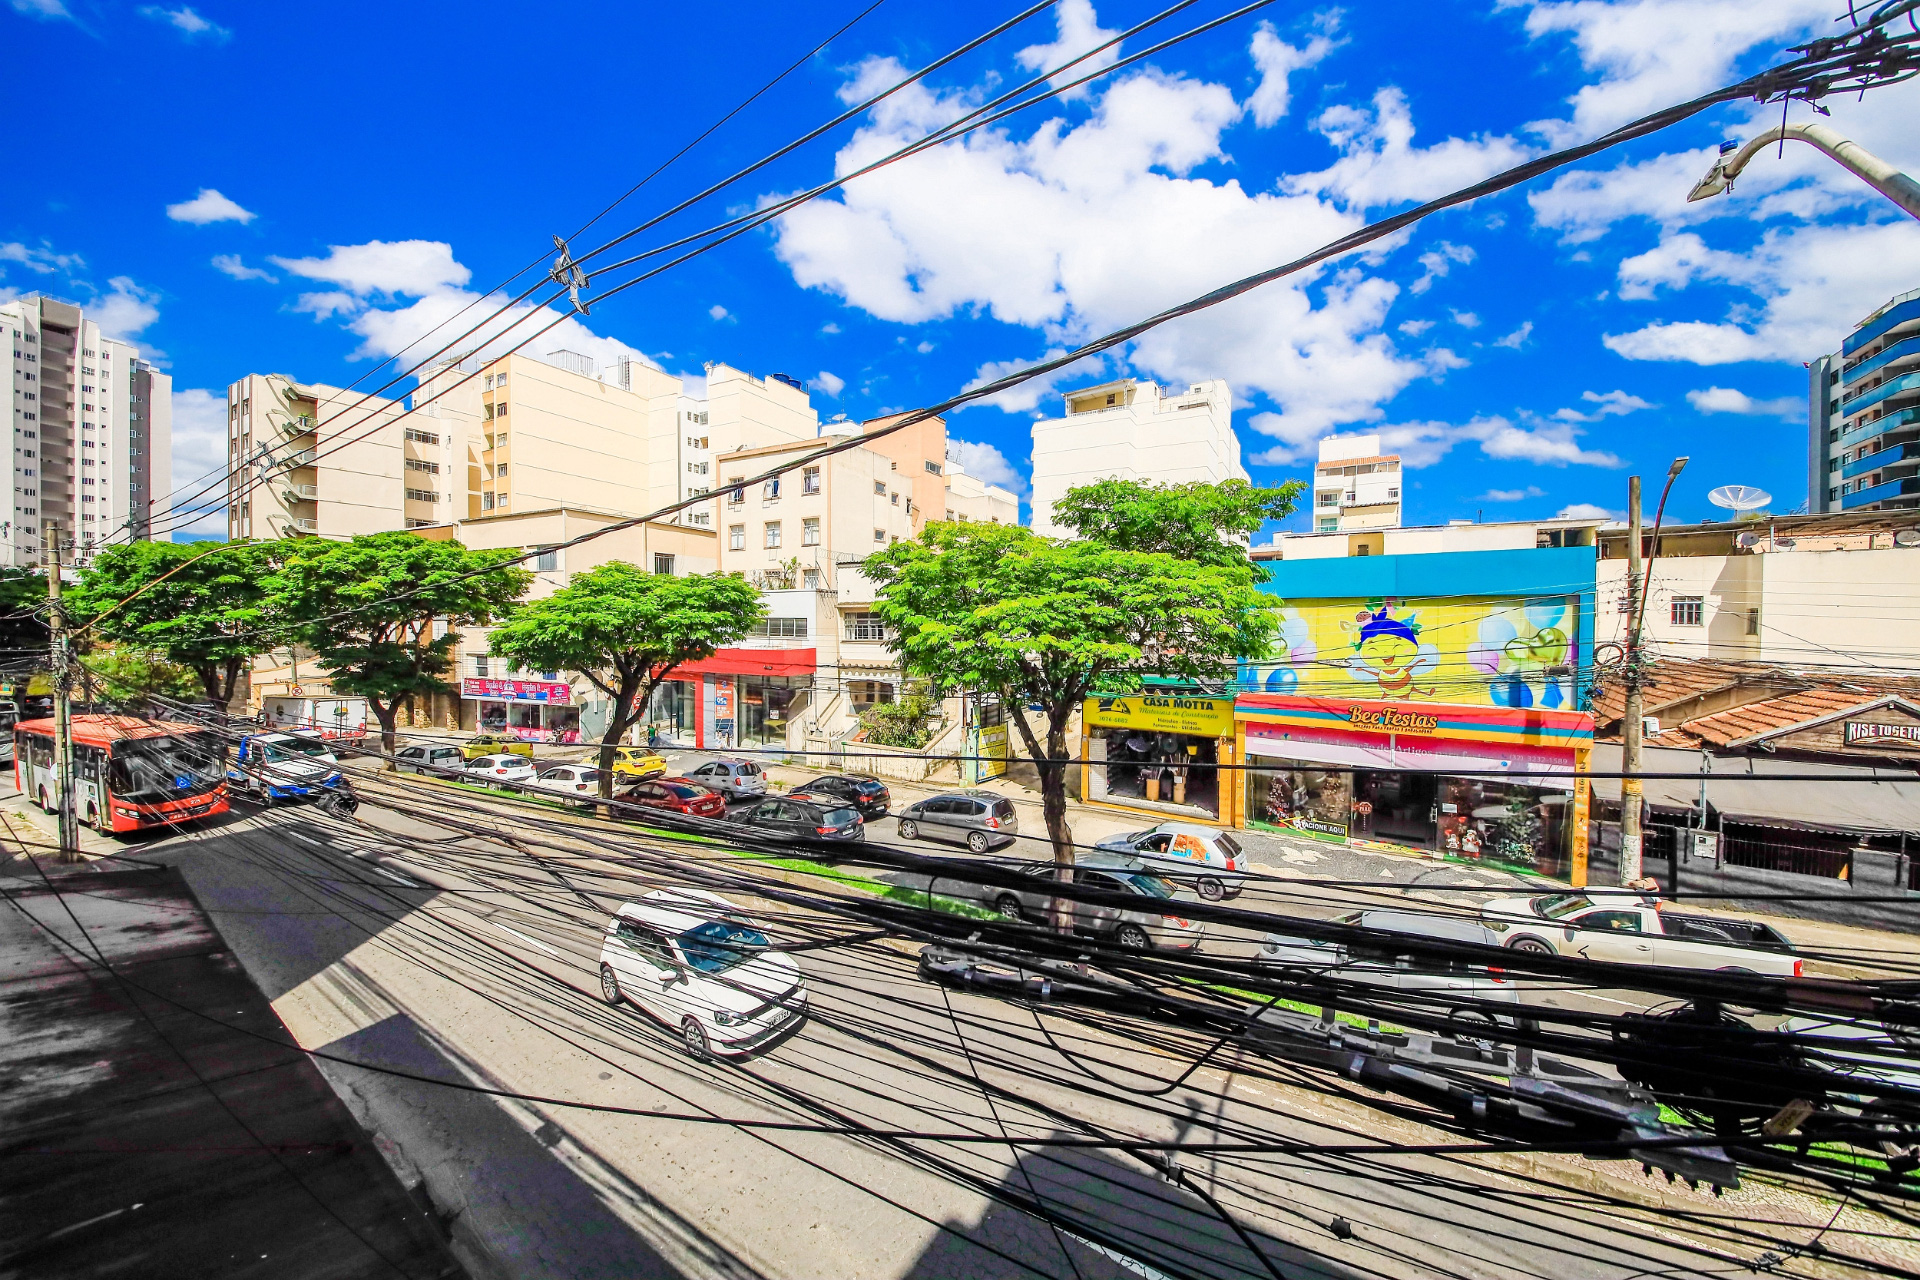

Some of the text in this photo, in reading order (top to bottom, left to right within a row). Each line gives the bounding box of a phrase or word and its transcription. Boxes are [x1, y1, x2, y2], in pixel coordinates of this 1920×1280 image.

[1143, 697, 1214, 710] CASA MOTTA
[1349, 705, 1438, 729] Bee Festas
[1849, 722, 1876, 741] RISE
[1396, 745, 1433, 757] Artigos
[1329, 826, 1345, 835] AQUI
